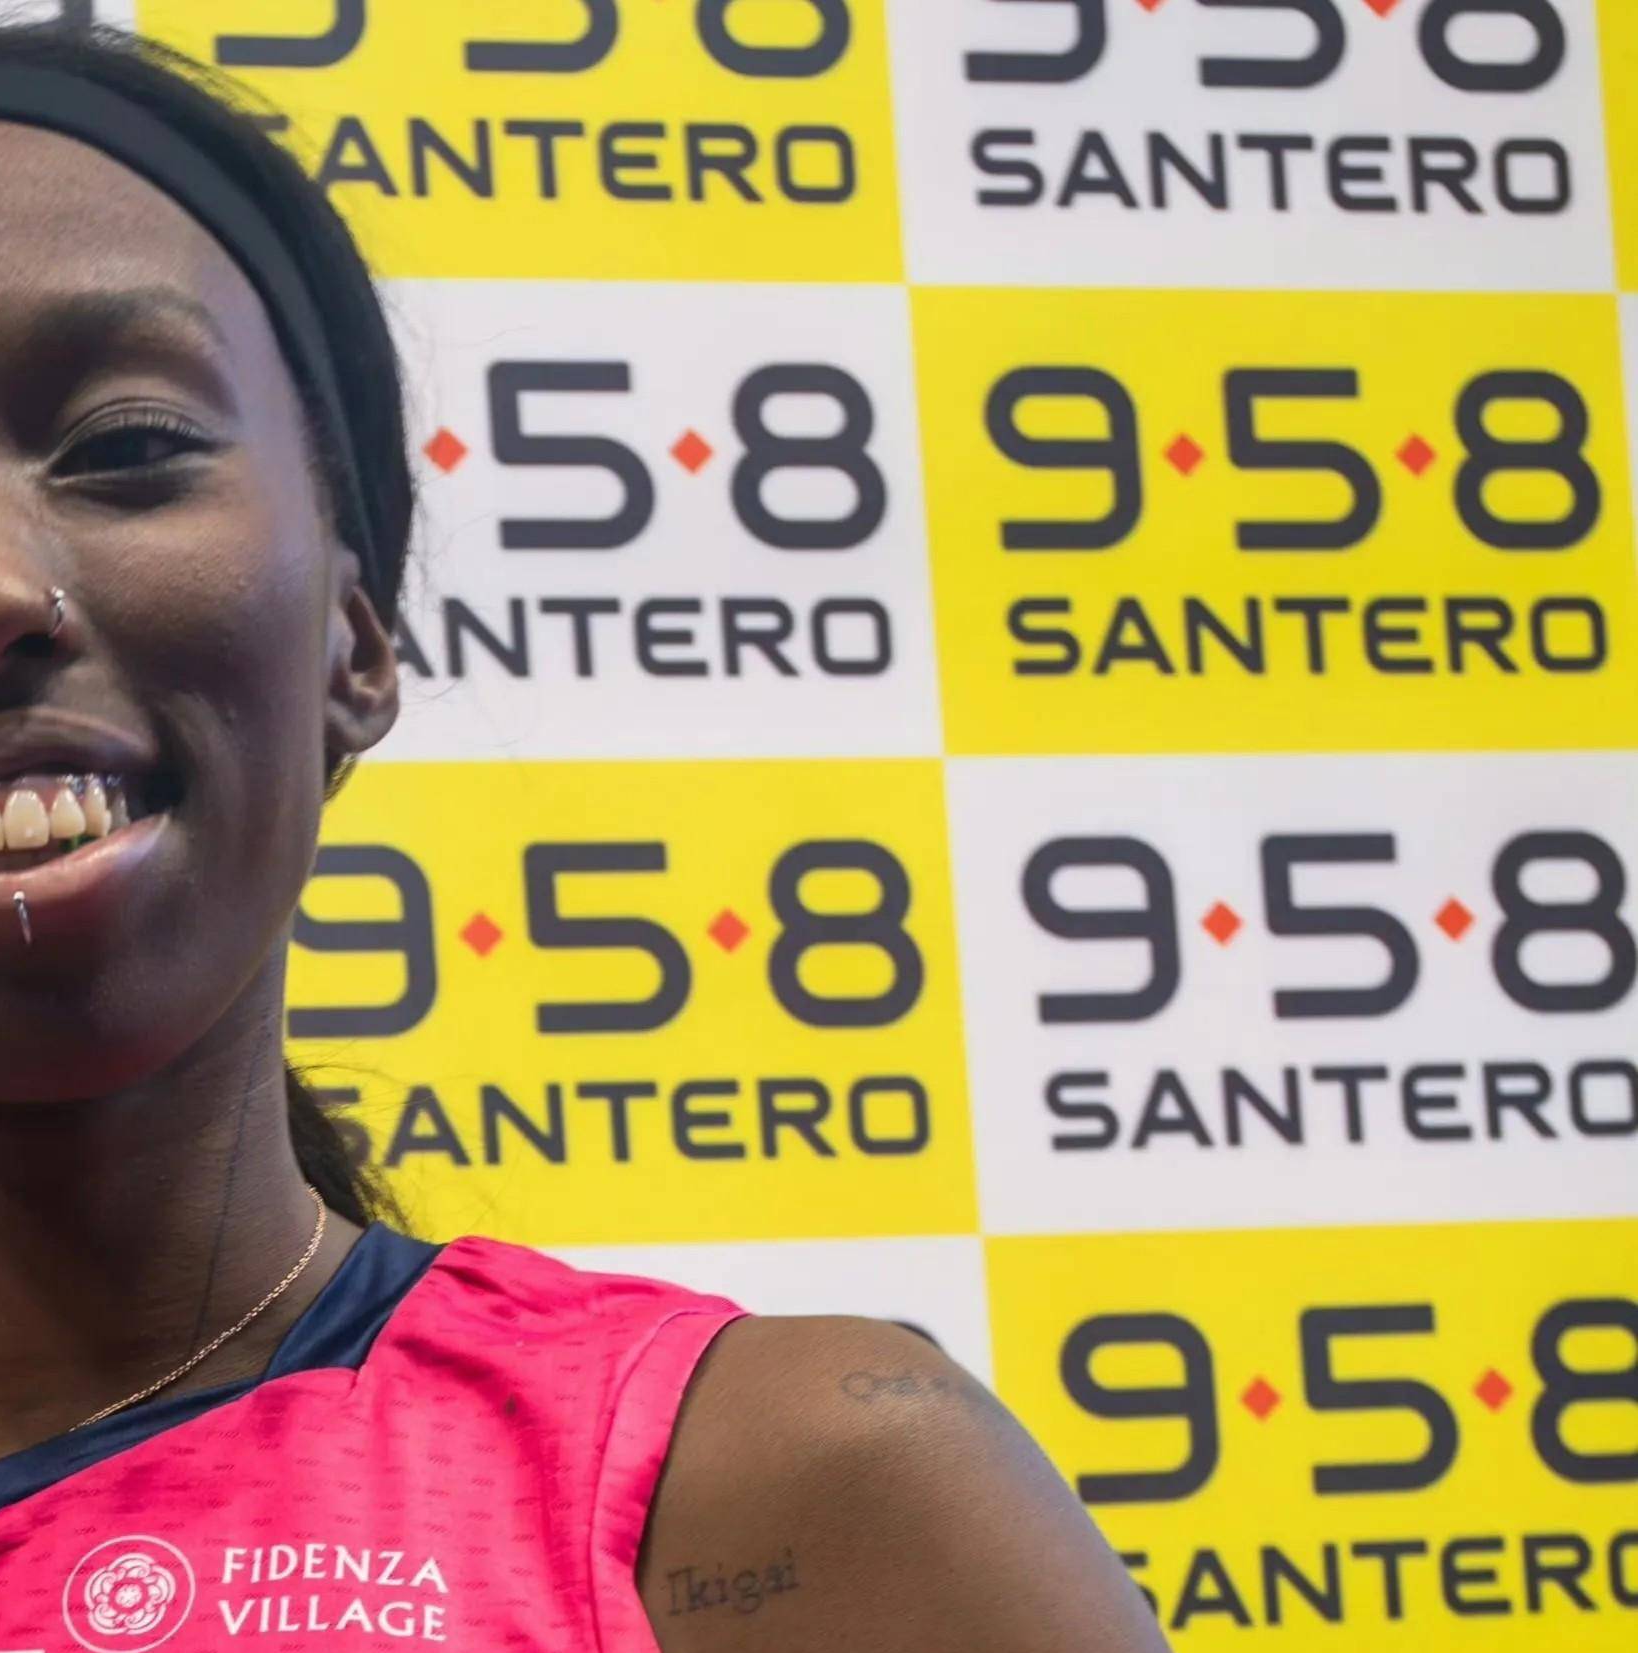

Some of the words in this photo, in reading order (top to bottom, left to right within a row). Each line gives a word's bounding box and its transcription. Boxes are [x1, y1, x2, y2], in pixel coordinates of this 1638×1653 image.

[970, 128, 1572, 215] SANTERO
[1006, 596, 1608, 676] SANTERO
[1044, 1059, 1638, 1151] SANTERO
[221, 1543, 450, 1595] FIDENZA
[666, 1546, 801, 1617] Ikigai
[219, 1597, 449, 1643] VILLAGE
